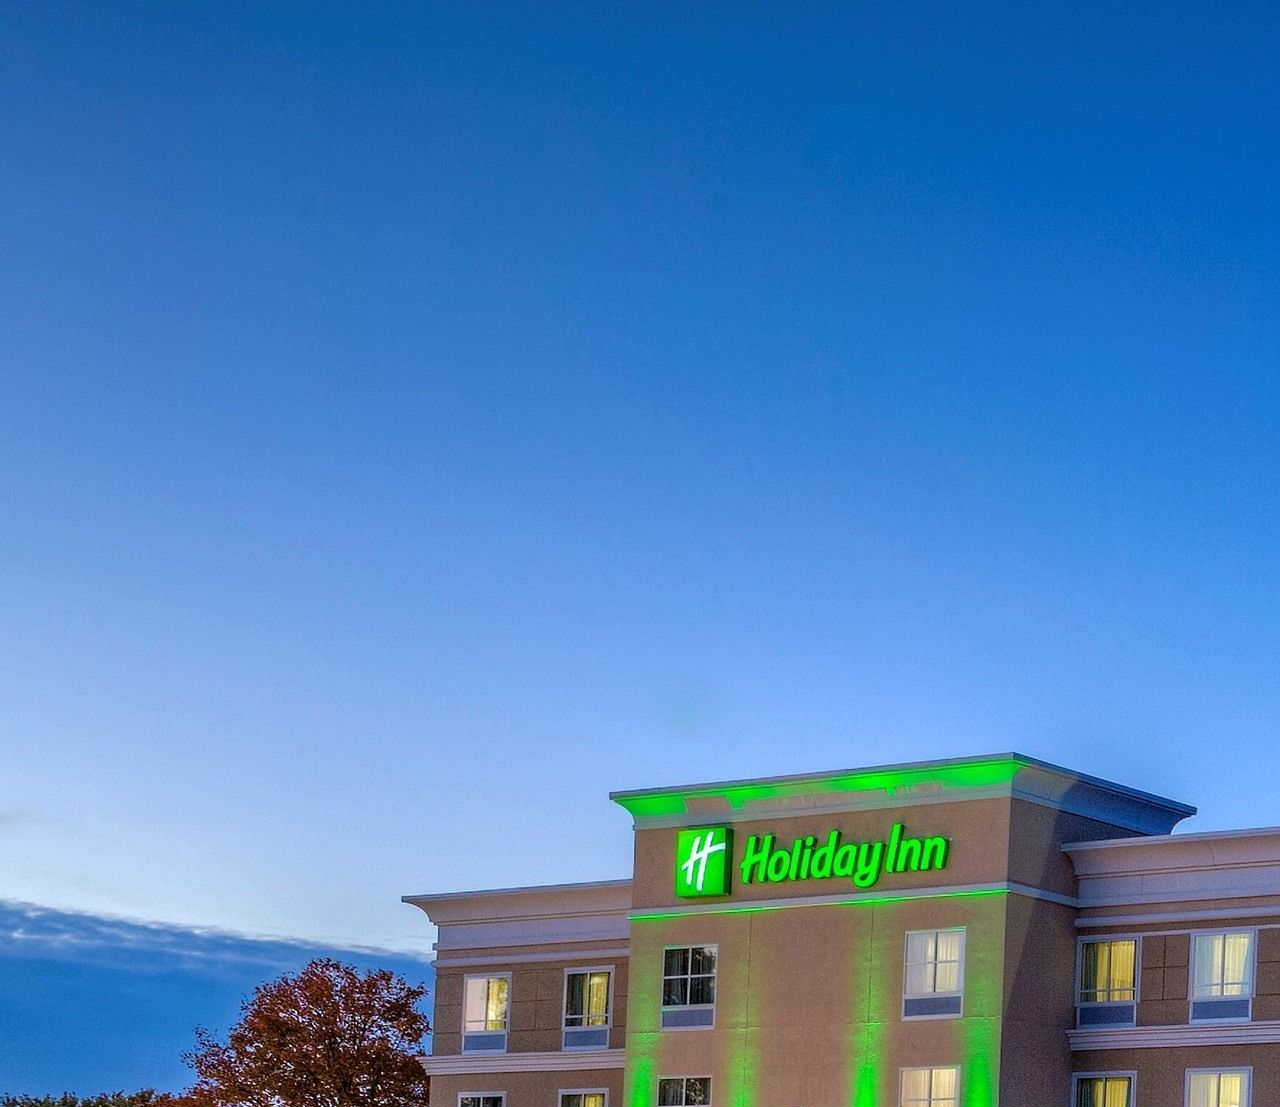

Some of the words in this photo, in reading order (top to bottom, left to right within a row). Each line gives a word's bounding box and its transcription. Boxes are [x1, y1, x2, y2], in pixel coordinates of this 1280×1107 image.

[681, 831, 726, 891] H
[740, 828, 885, 888] Holiday
[885, 822, 949, 873] Inn
